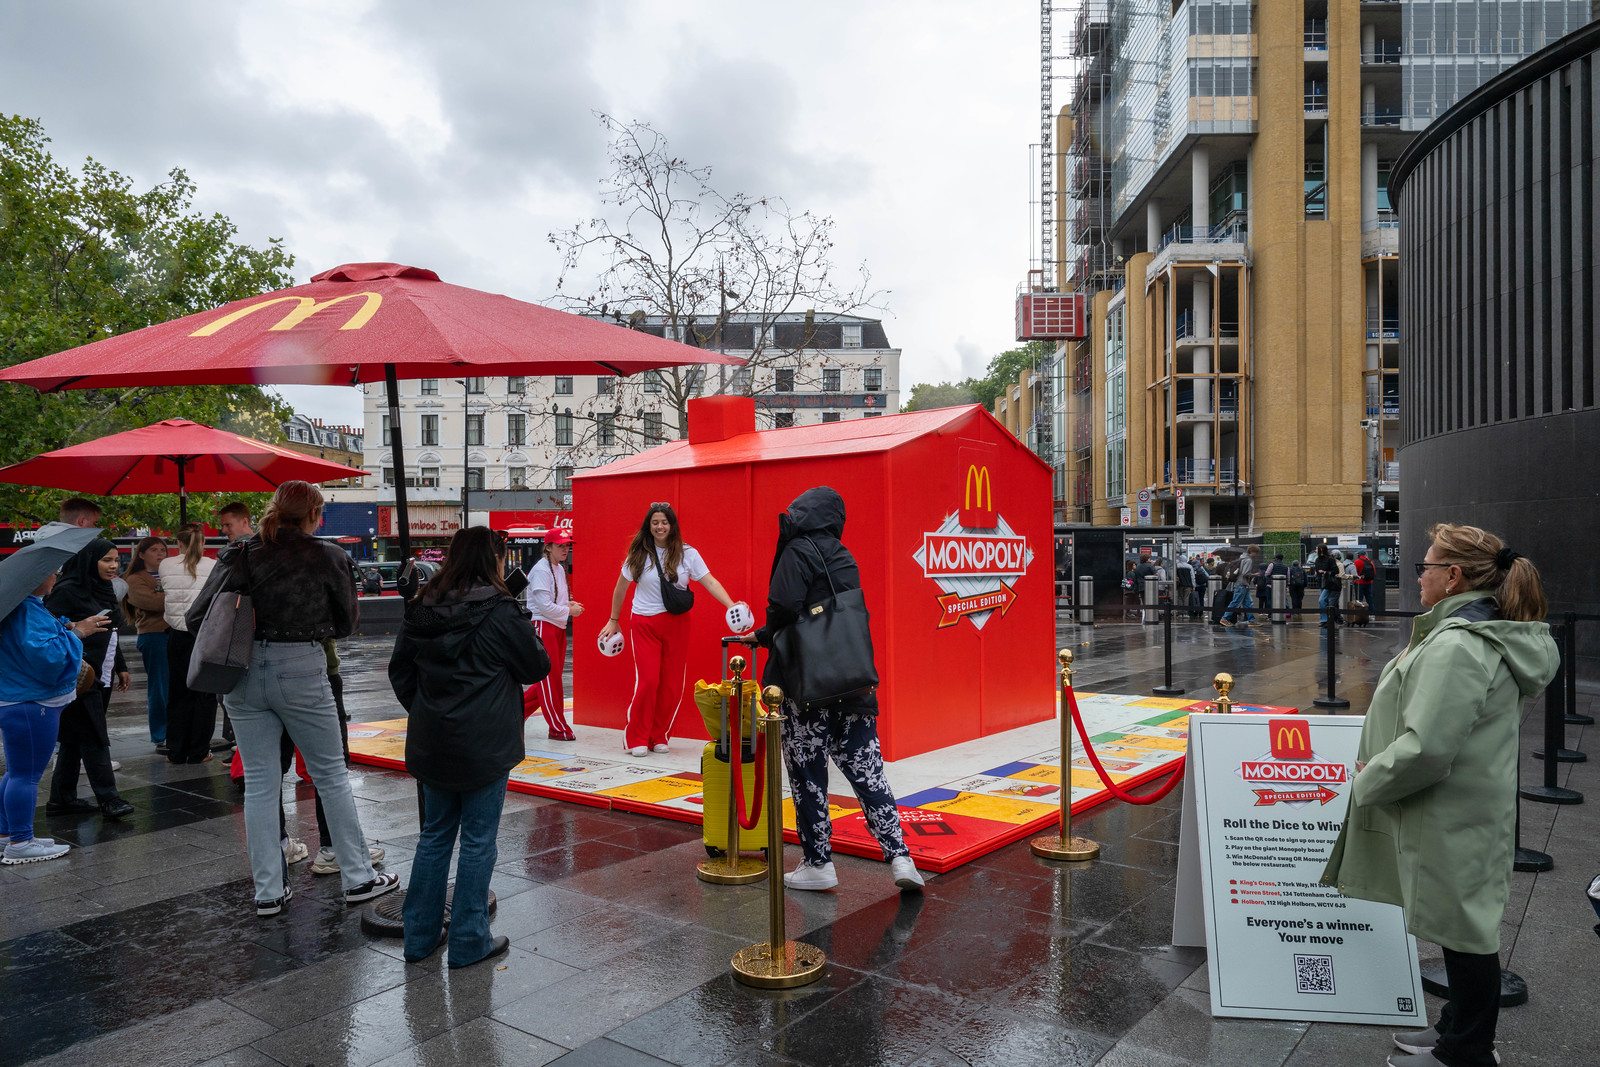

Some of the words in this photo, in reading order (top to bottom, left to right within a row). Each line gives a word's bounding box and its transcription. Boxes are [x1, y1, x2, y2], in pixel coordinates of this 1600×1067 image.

[804, 396, 820, 406] INN
[823, 395, 855, 406] HOTEL
[440, 520, 460, 531] Inn
[929, 539, 1024, 570] MONOPOLY
[947, 599, 978, 614] SPECIAL
[980, 593, 1008, 607] EDITION
[1245, 763, 1344, 781] MONOPOLY
[1223, 818, 1247, 829] Roll
[1249, 819, 1270, 829] the
[1272, 820, 1300, 830] Dice
[1302, 821, 1315, 831] to
[1316, 921, 1324, 929] a
[1326, 919, 1373, 932] winner.
[1278, 932, 1307, 943] Your
[1309, 935, 1344, 945] move
